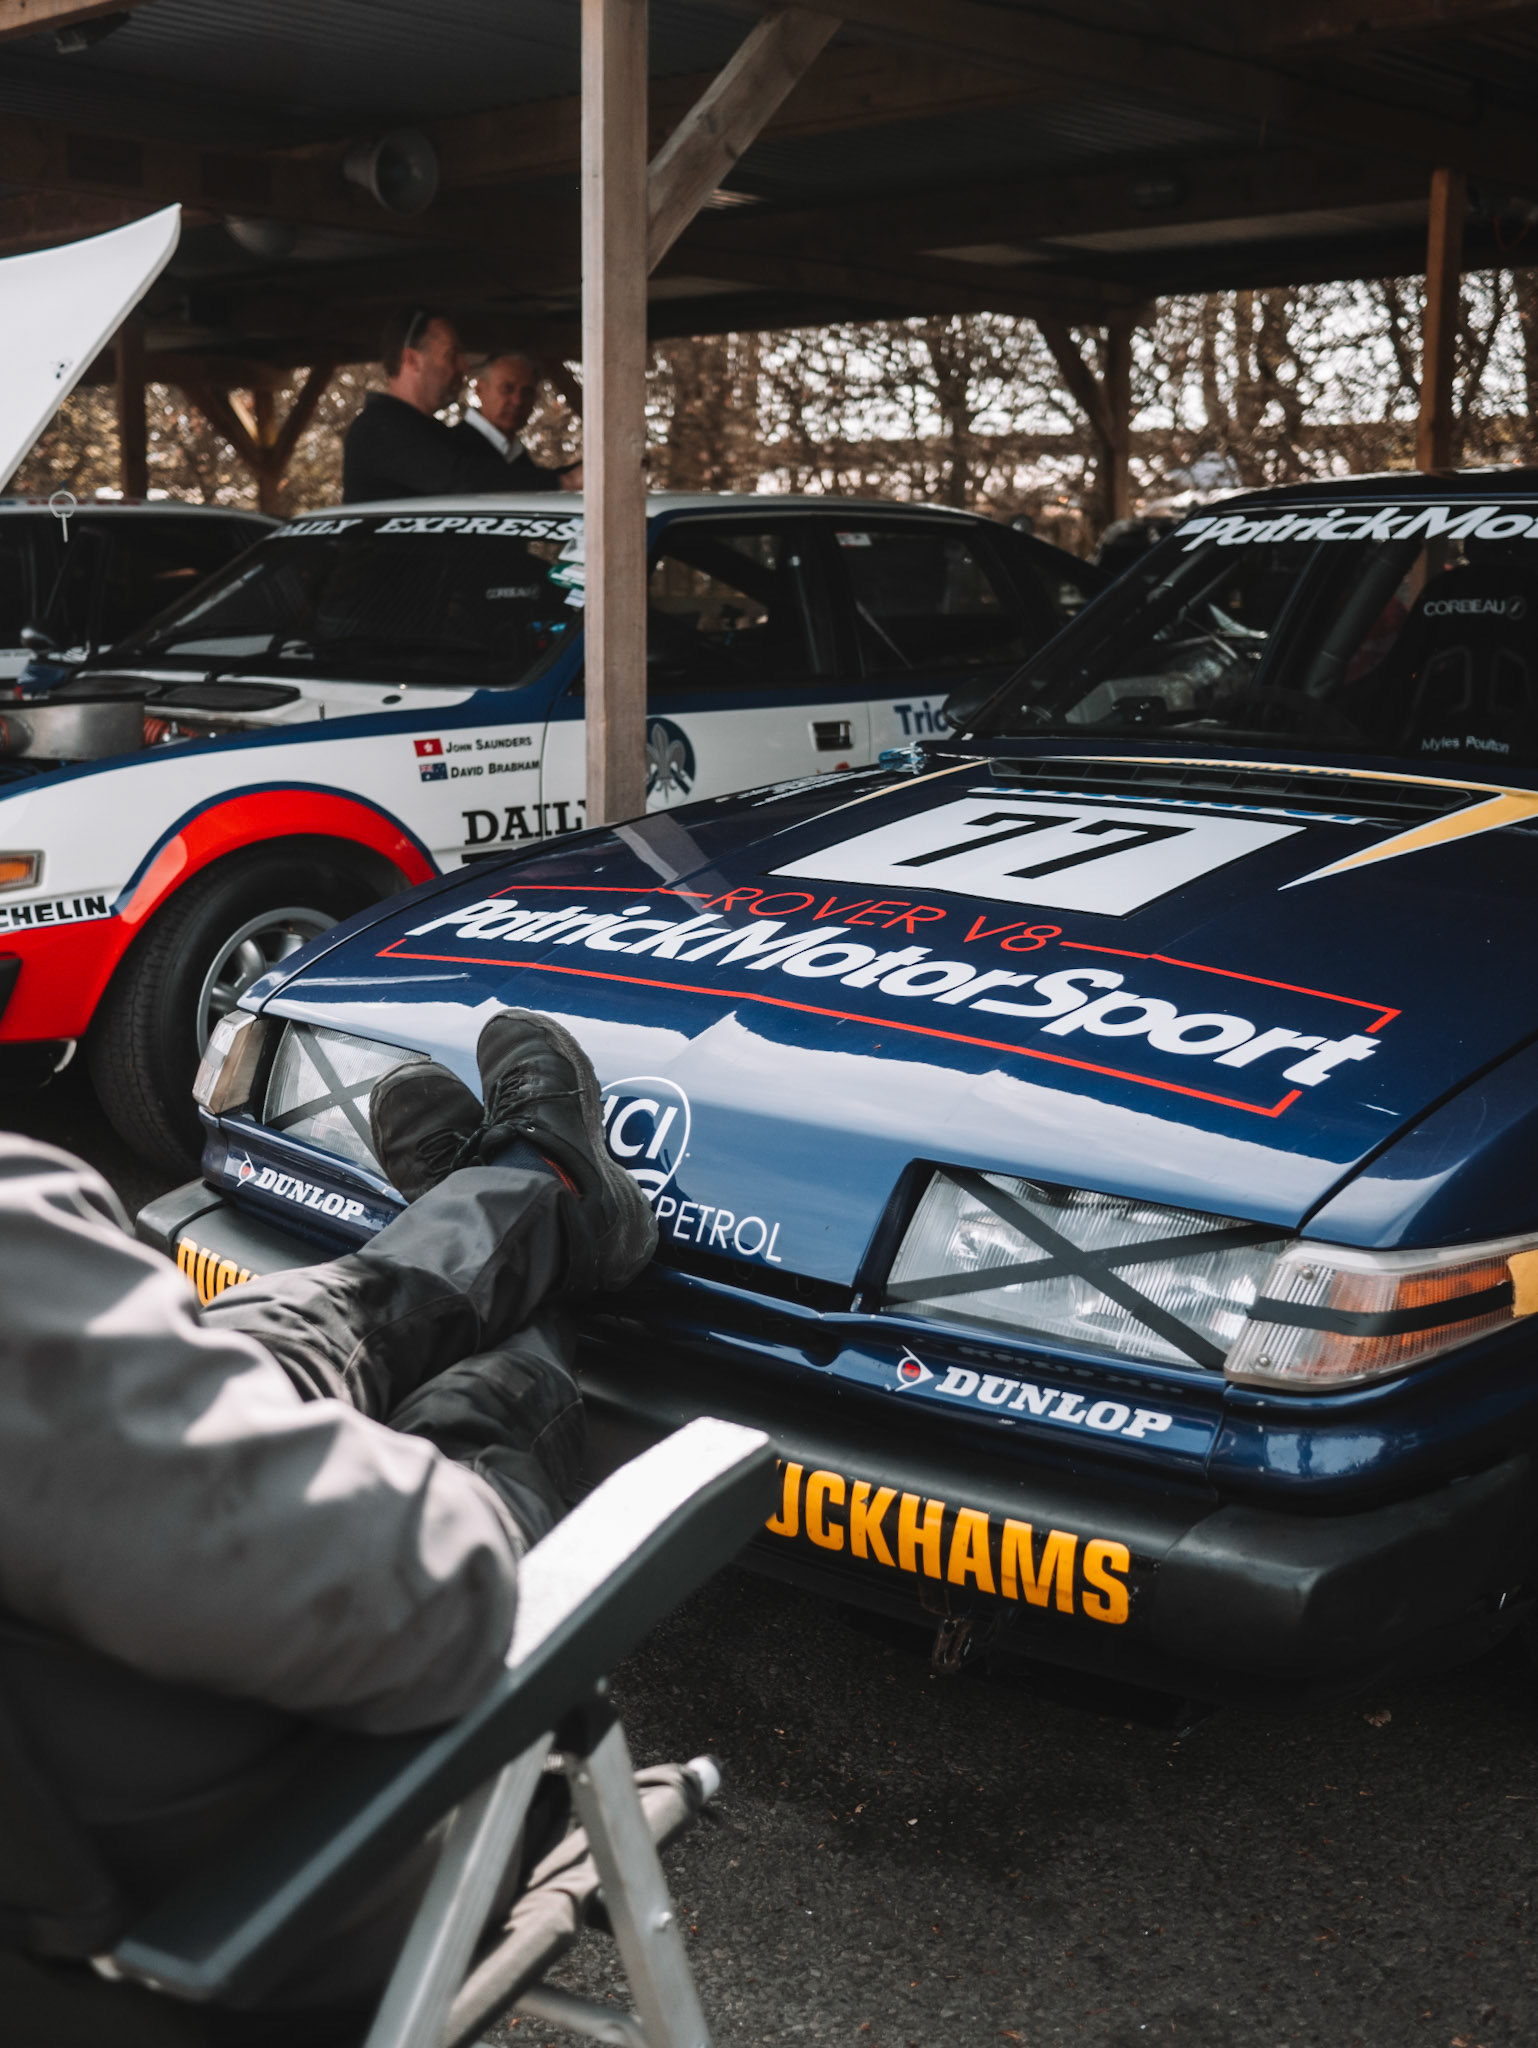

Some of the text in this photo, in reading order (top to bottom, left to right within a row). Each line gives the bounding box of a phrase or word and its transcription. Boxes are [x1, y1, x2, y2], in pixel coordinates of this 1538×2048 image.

[374, 517, 582, 541] EXPRESS
[462, 800, 586, 846] DAIL
[890, 812, 1197, 880] 77
[702, 887, 1062, 951] ROVER V8
[255, 1167, 365, 1221] DUNLOP
[656, 1196, 782, 1262] PETROL
[935, 1366, 1173, 1438] DUNLOP
